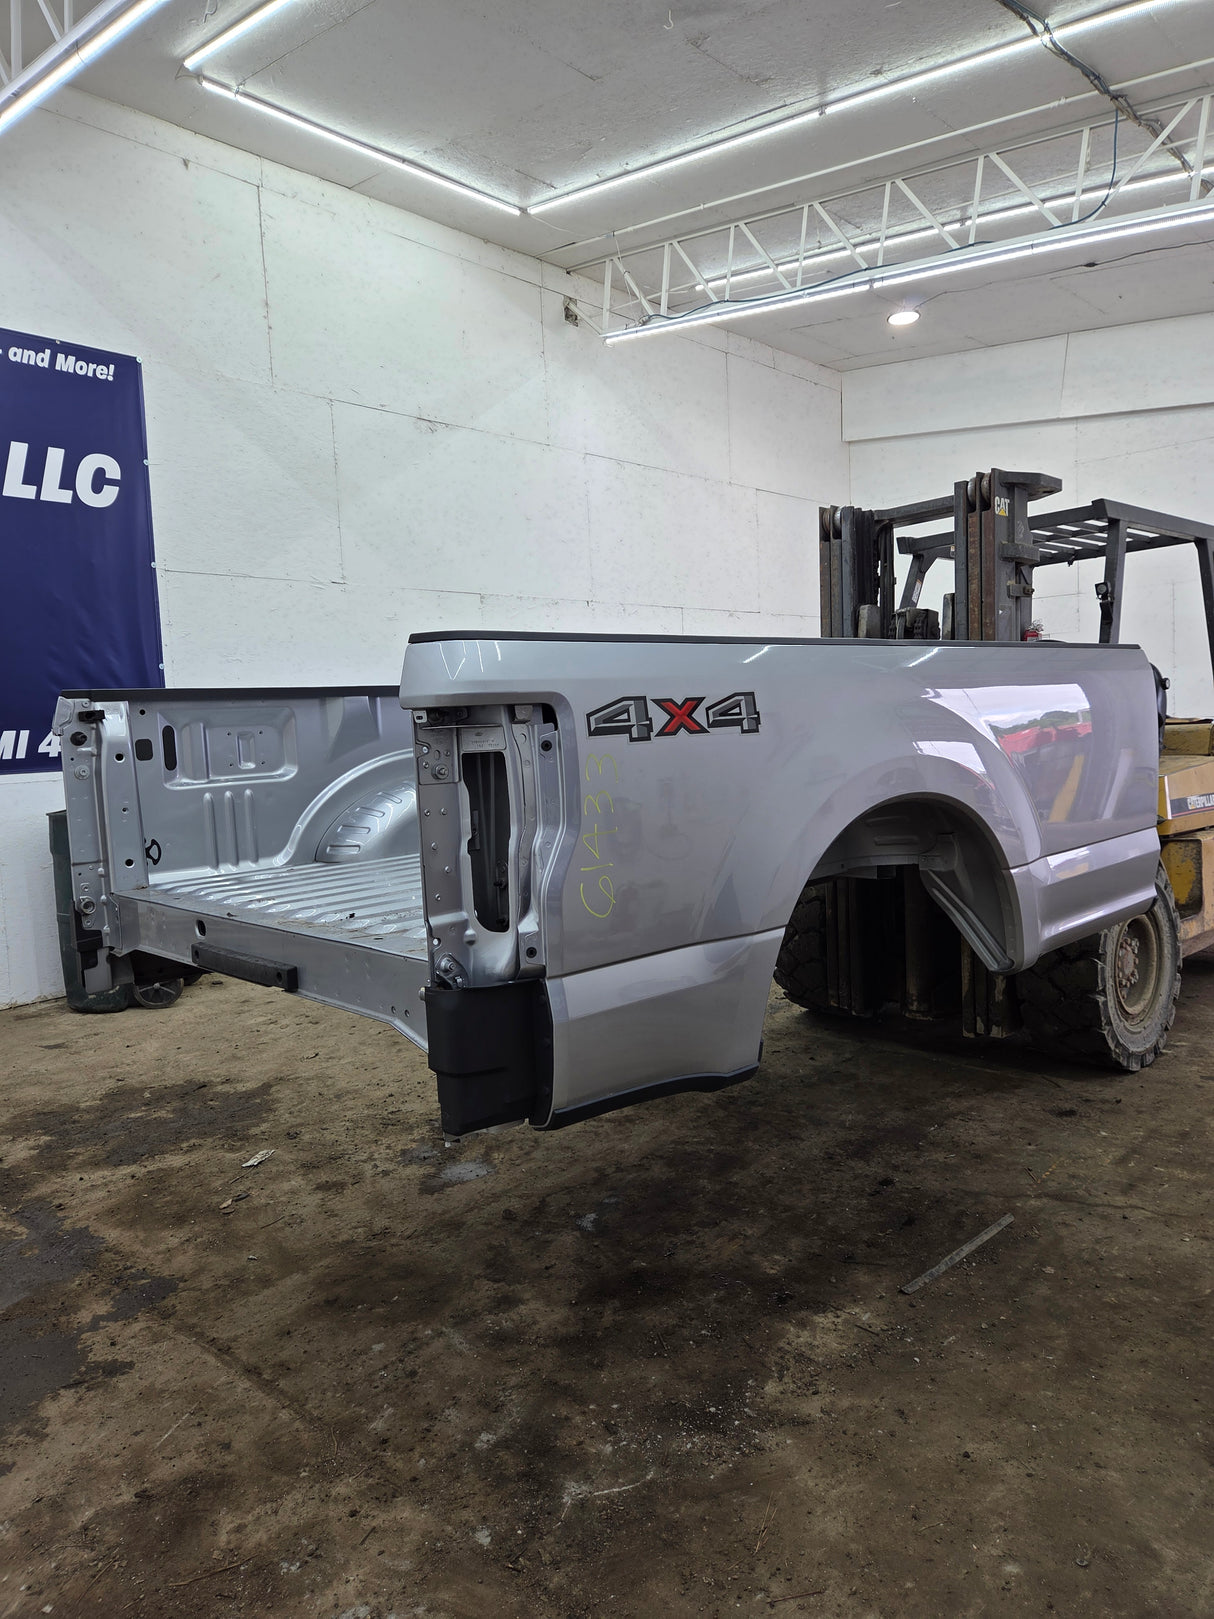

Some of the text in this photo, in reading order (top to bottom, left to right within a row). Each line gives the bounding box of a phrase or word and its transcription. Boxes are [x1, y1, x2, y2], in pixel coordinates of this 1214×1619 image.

[8, 346, 115, 381] and More!
[2, 440, 121, 508] LLC
[994, 496, 1010, 517] CAT
